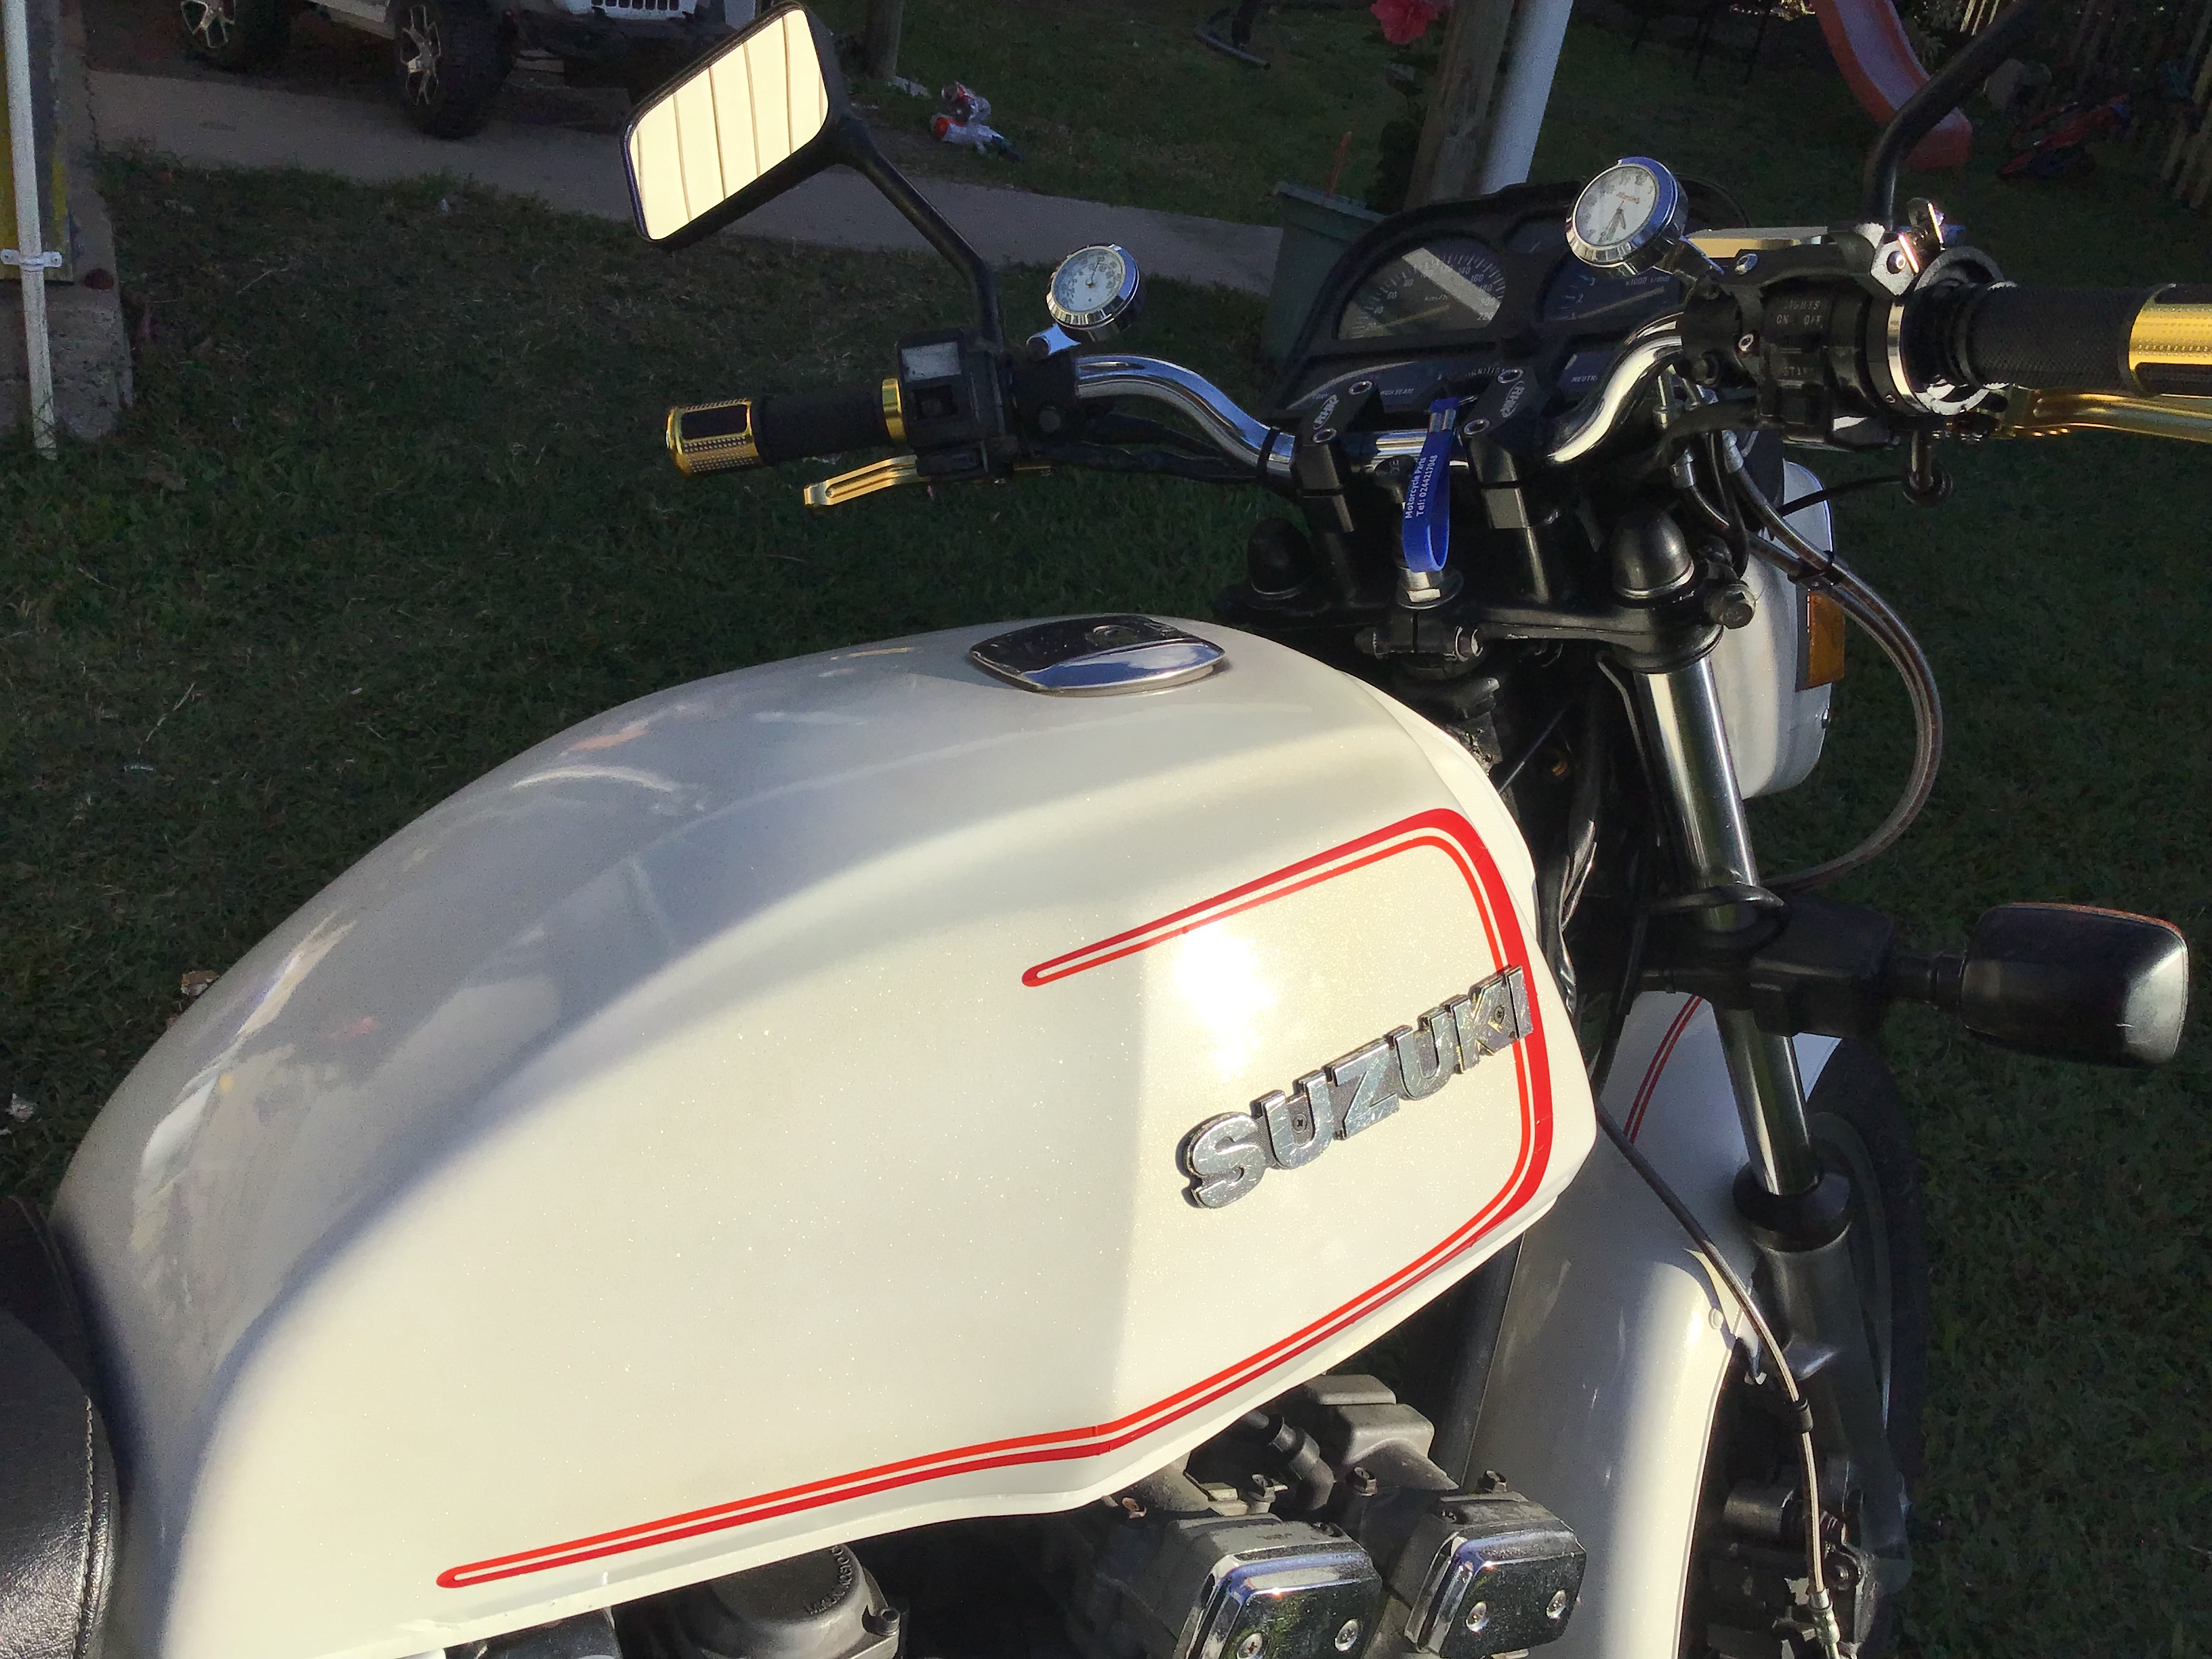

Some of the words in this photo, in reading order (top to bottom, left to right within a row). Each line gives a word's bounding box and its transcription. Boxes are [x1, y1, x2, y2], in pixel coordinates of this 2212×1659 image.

[1471, 273, 1484, 283] 160
[1387, 291, 1397, 300] 60
[1776, 314, 1790, 325] ON
[1804, 314, 1823, 326] OFF
[1418, 455, 1438, 498] 0244217048
[1405, 475, 1421, 519] Motorcycle
[1414, 457, 1427, 475] Parts
[1416, 499, 1426, 517] Tel:
[1183, 965, 1534, 1209] SUZUKI
